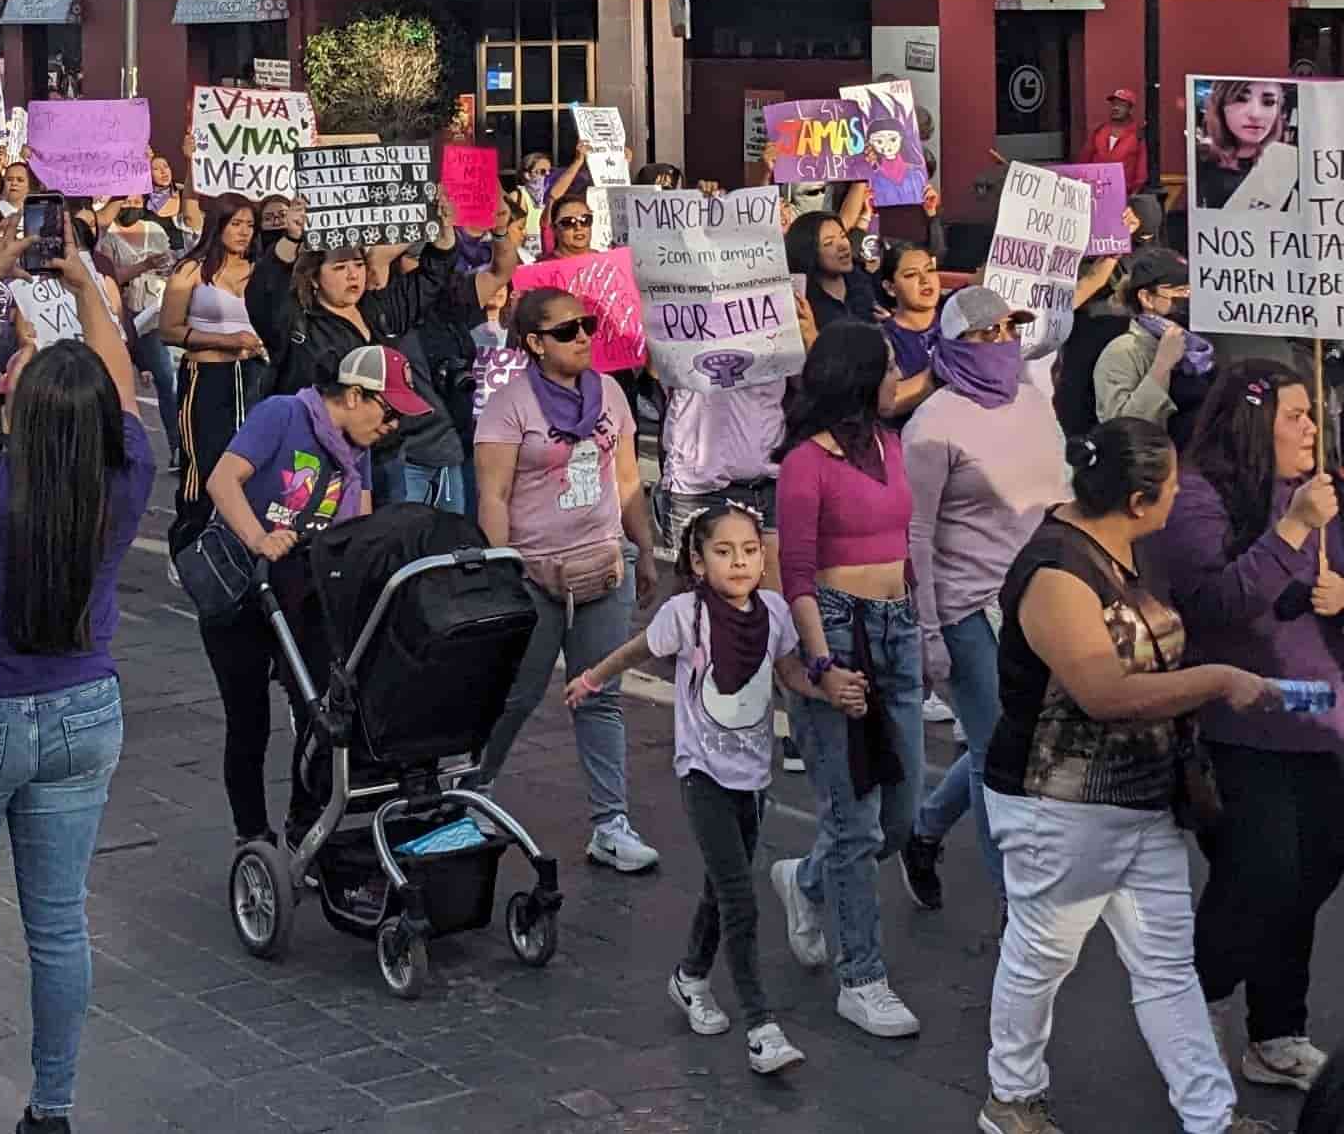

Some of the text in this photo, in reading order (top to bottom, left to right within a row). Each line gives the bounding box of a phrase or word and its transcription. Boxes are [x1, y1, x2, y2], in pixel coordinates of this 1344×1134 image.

[212, 87, 290, 120] VIVA
[207, 122, 299, 155] VIVAS
[299, 146, 430, 167] POR LAS QUE
[298, 166, 427, 186] SALIERON Y
[1009, 169, 1041, 197] HOY
[299, 186, 369, 206] NUNCA
[306, 208, 427, 231] VOLVIERON
[635, 197, 724, 229] MARCHO
[736, 193, 777, 225] HOY
[1026, 207, 1054, 236] POR
[666, 244, 766, 270] con mi amiga
[990, 236, 1045, 272] ABUSOS
[1197, 226, 1344, 261] NOS FALTA
[988, 272, 1024, 304] QUE
[1199, 267, 1274, 295] KAREN
[663, 294, 781, 340] POR ELLA
[1217, 300, 1318, 328] SALAZAR
